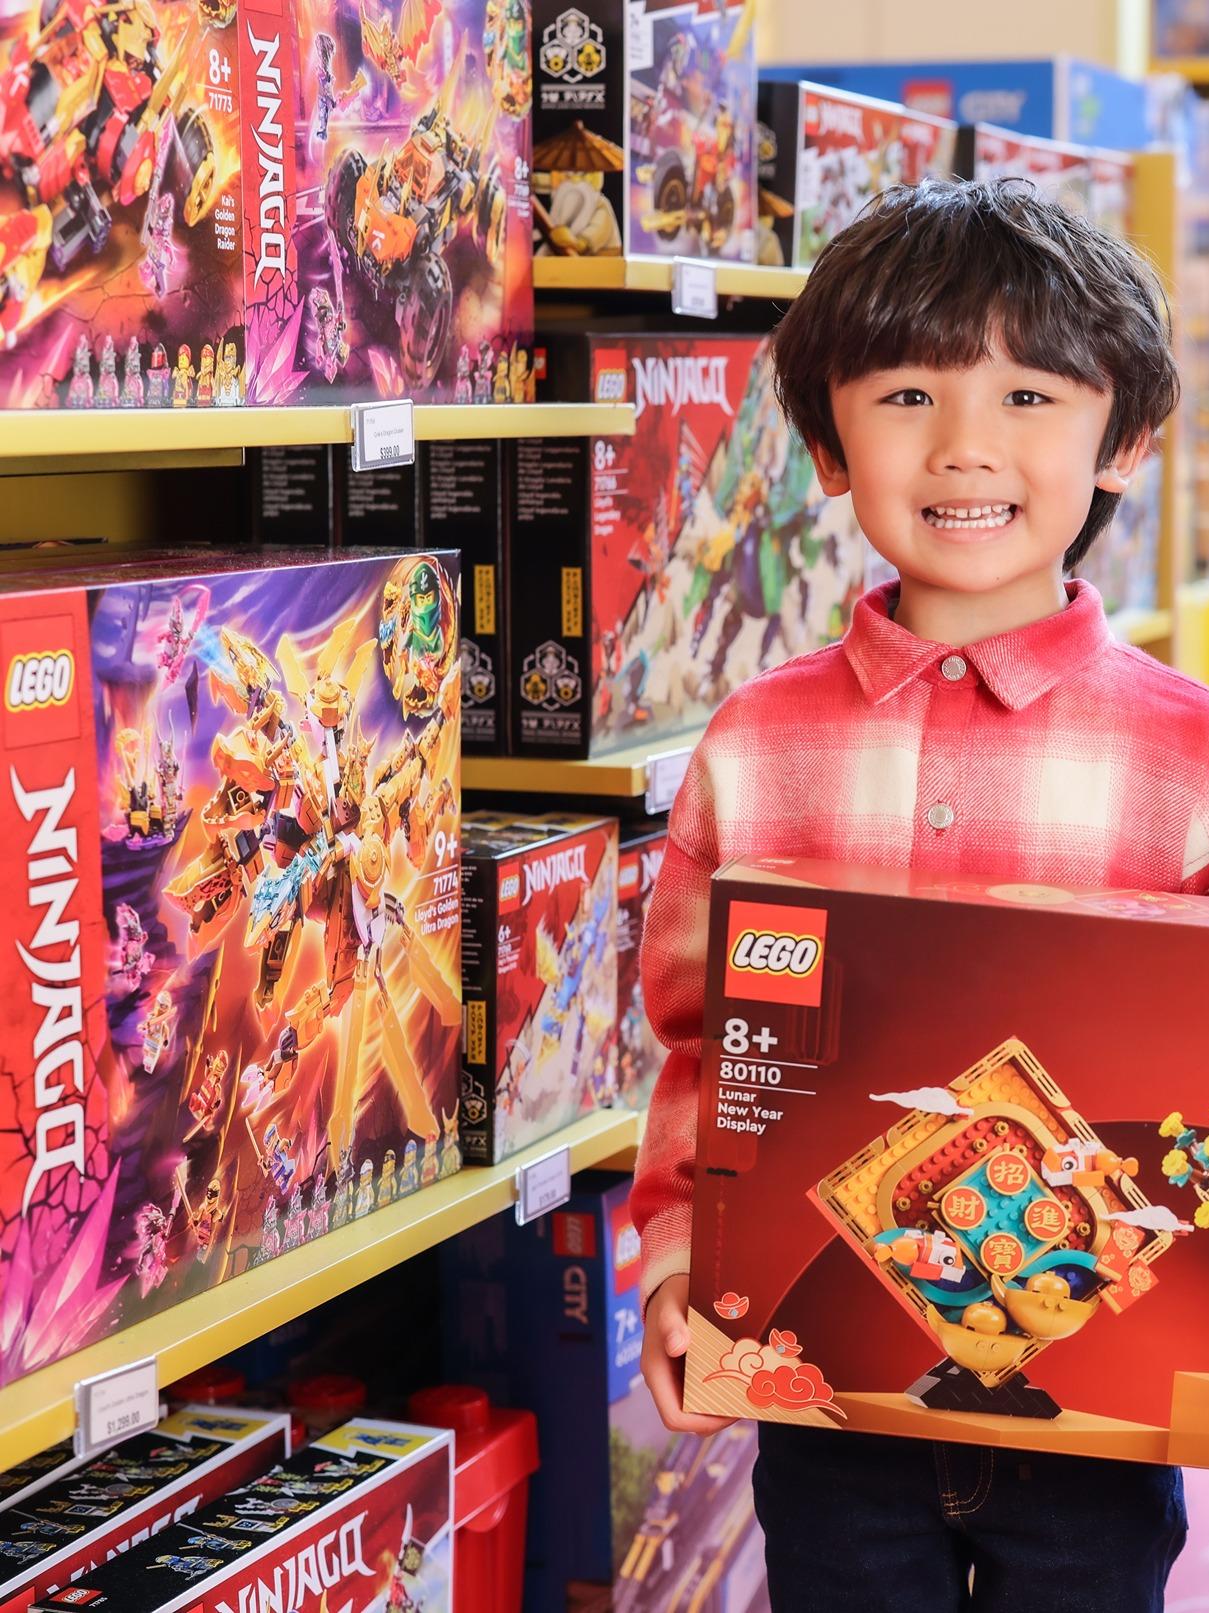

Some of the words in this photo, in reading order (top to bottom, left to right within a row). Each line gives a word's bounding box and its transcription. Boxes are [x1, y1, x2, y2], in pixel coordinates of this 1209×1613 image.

[208, 48, 232, 86] 8+
[208, 92, 233, 113] 71773
[247, 17, 286, 290] NINJAGO
[222, 195, 235, 207] Kai's
[214, 208, 235, 221] Golden
[214, 223, 236, 238] Dragon
[217, 237, 236, 251] Raider
[631, 356, 735, 419] NINJAGO
[594, 440, 616, 471] 8+
[7, 651, 73, 710] LEGO
[434, 831, 458, 868] 9+
[433, 871, 458, 897] 71774
[500, 875, 520, 901] LEGO
[522, 845, 591, 907] NINJAGO
[415, 903, 437, 922] Lloyd's
[437, 899, 459, 914] Golden
[421, 919, 437, 936] Ultra
[437, 914, 459, 931] Dragon
[728, 929, 824, 978] LEGO
[9, 763, 86, 1219] NINJAGO
[722, 1018, 778, 1054] 8+
[720, 1061, 781, 1085] 80110
[718, 1087, 757, 1103] Lunar
[717, 1101, 749, 1116] New
[752, 1105, 784, 1121] Year
[716, 1116, 766, 1136] Display
[994, 1160, 1026, 1186] 招
[949, 1195, 981, 1221] 財
[1031, 1206, 1062, 1233] 進
[563, 1264, 588, 1325] CITY
